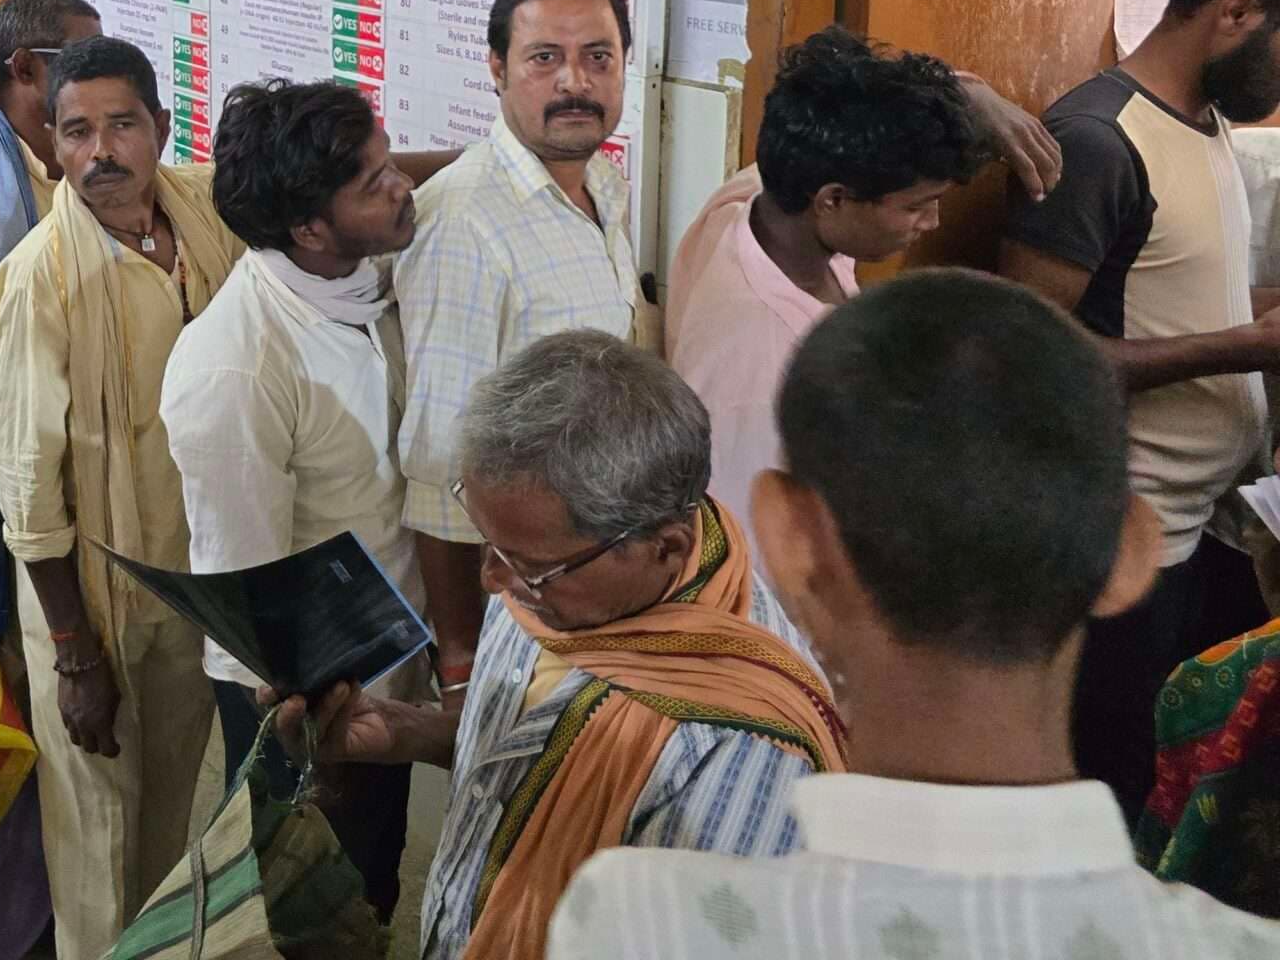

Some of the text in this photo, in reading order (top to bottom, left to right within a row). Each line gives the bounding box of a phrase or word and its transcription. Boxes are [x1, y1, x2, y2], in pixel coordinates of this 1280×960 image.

[344, 18, 372, 36] YES NO
[686, 16, 713, 33] FREE
[399, 30, 409, 41] 81
[343, 49, 372, 68] YES NO
[399, 63, 410, 76] 82
[399, 98, 409, 111] 83
[398, 134, 408, 145] 84
